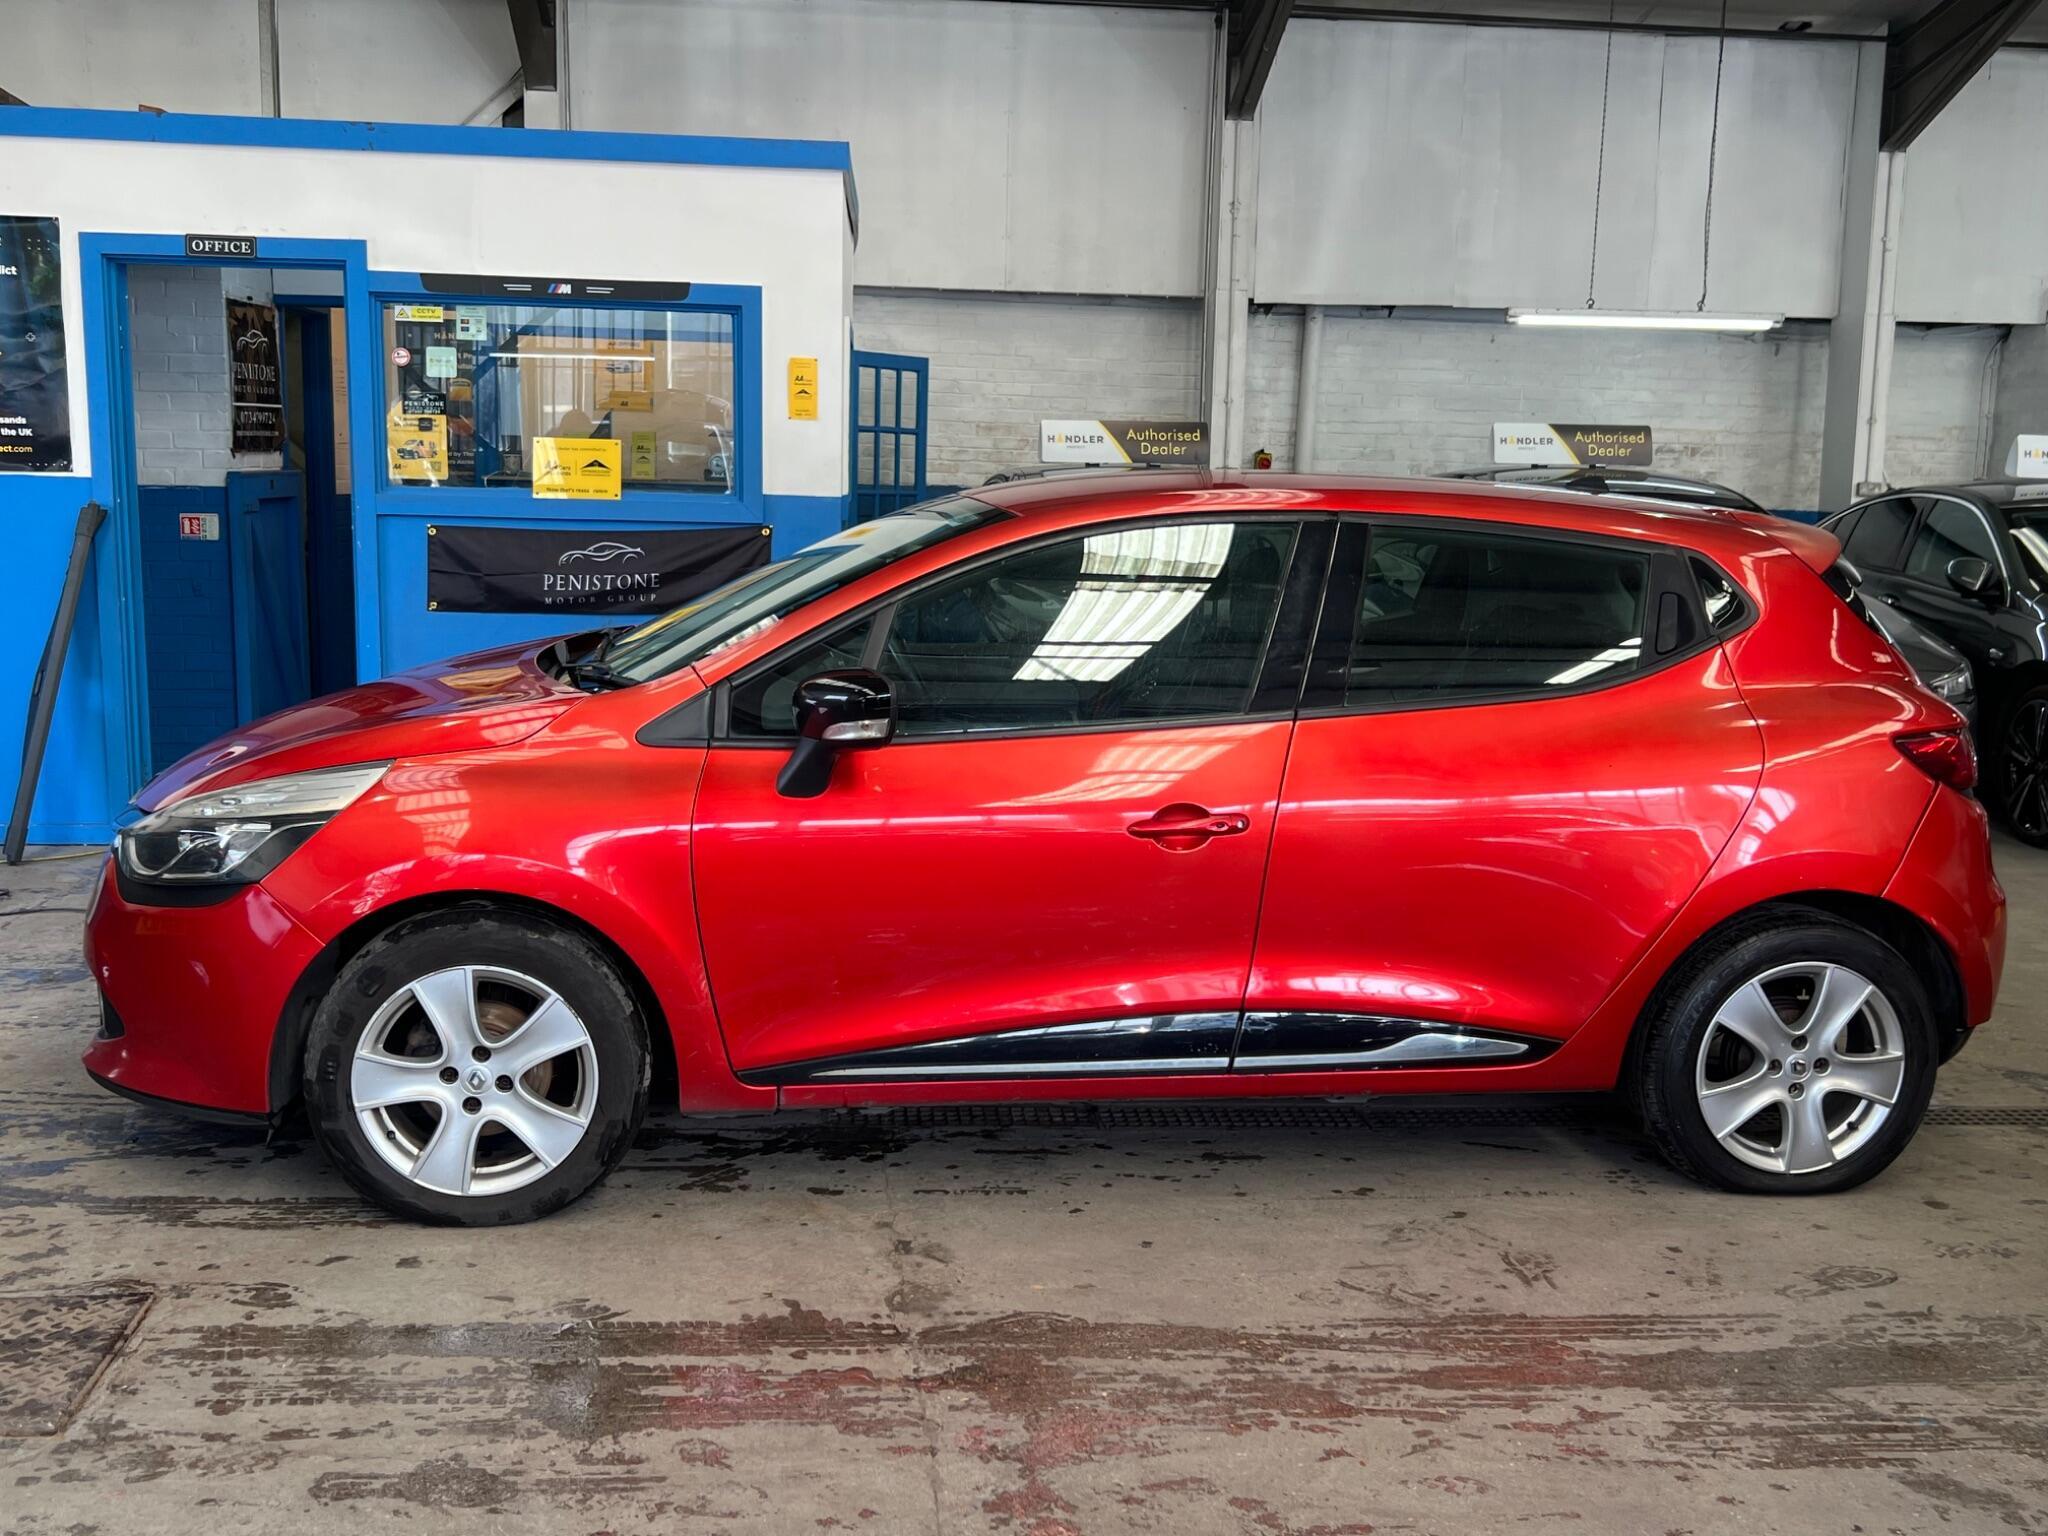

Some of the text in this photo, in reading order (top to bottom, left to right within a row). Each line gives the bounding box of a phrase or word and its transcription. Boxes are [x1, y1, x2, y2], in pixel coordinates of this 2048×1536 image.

[191, 239, 251, 253] OFFICE
[0, 427, 33, 436] the UK
[1126, 428, 1201, 442] Authorised
[1574, 431, 1645, 444] Authorised
[1140, 443, 1188, 455] Dealer
[1588, 444, 1632, 457] Dealer
[543, 572, 660, 591] PENISTONE
[545, 593, 656, 605] MOTOR GROUP
